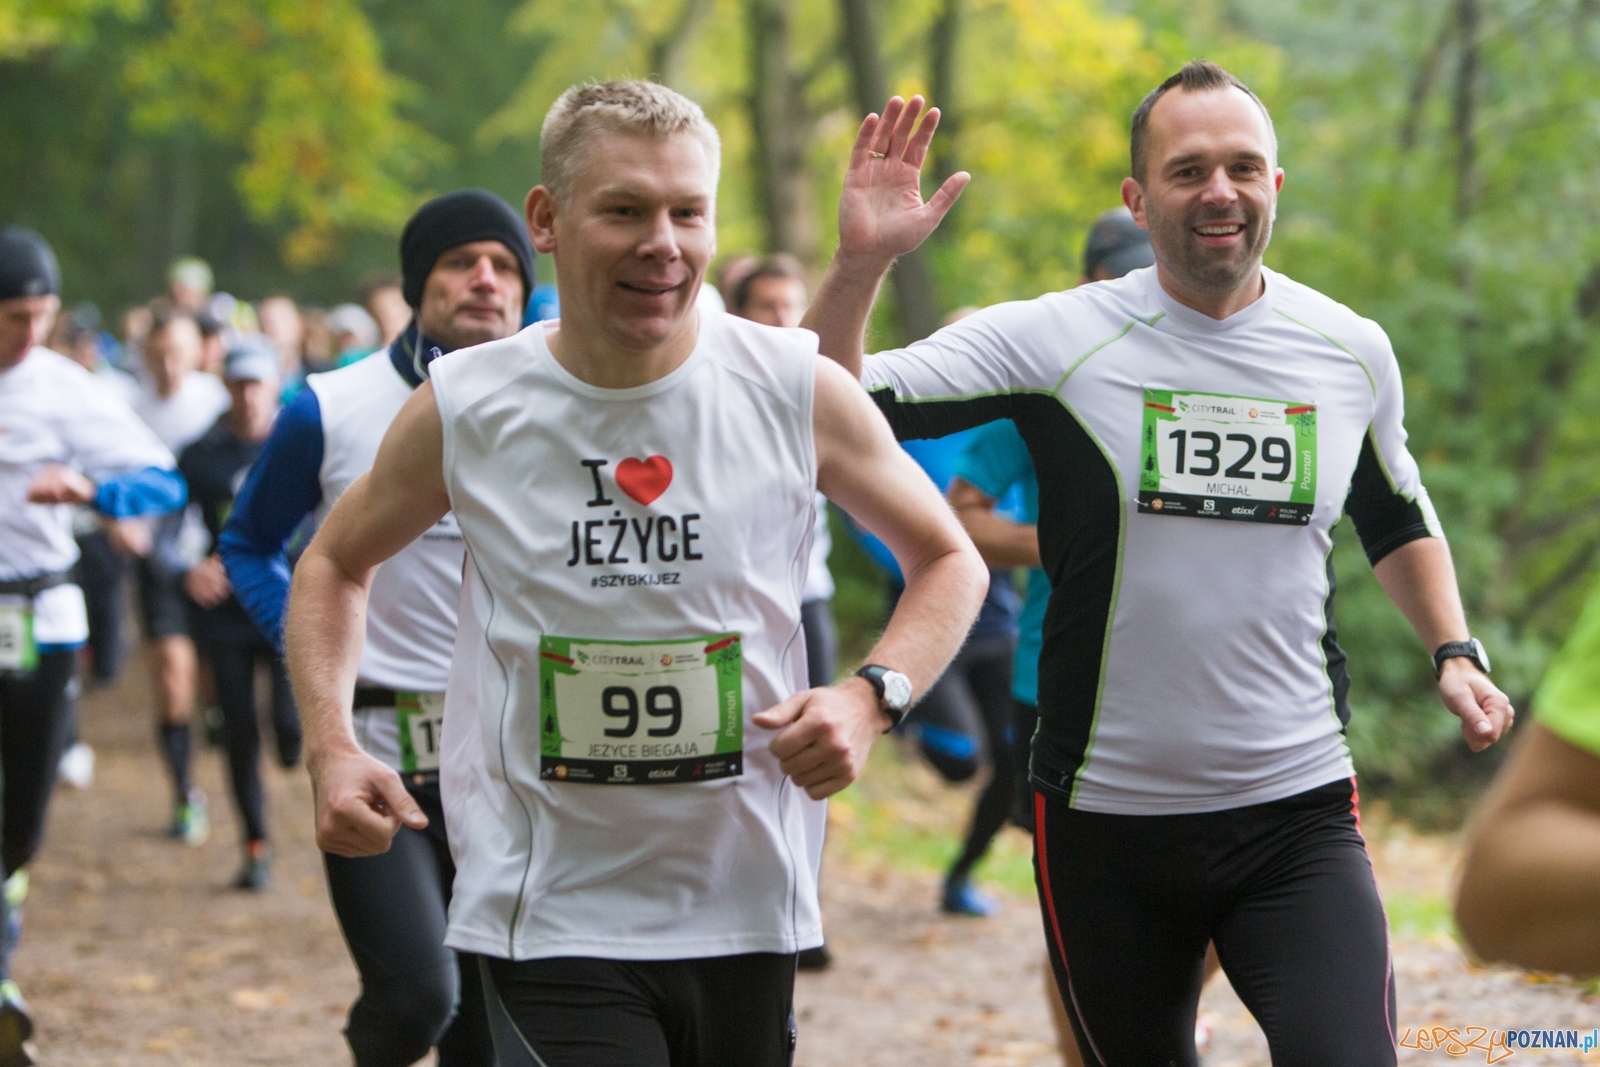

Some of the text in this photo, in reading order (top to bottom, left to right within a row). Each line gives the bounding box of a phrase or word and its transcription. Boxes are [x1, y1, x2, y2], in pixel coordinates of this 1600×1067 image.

[1168, 429, 1292, 482] 1329
[1300, 450, 1312, 491] Poznań
[580, 459, 613, 507] I
[1205, 482, 1251, 497] MICHAŁ
[567, 510, 702, 567] JEŻYCE
[591, 573, 680, 588] #SZYBKIJEZ
[602, 685, 682, 738] 99
[725, 690, 736, 737] Poznań
